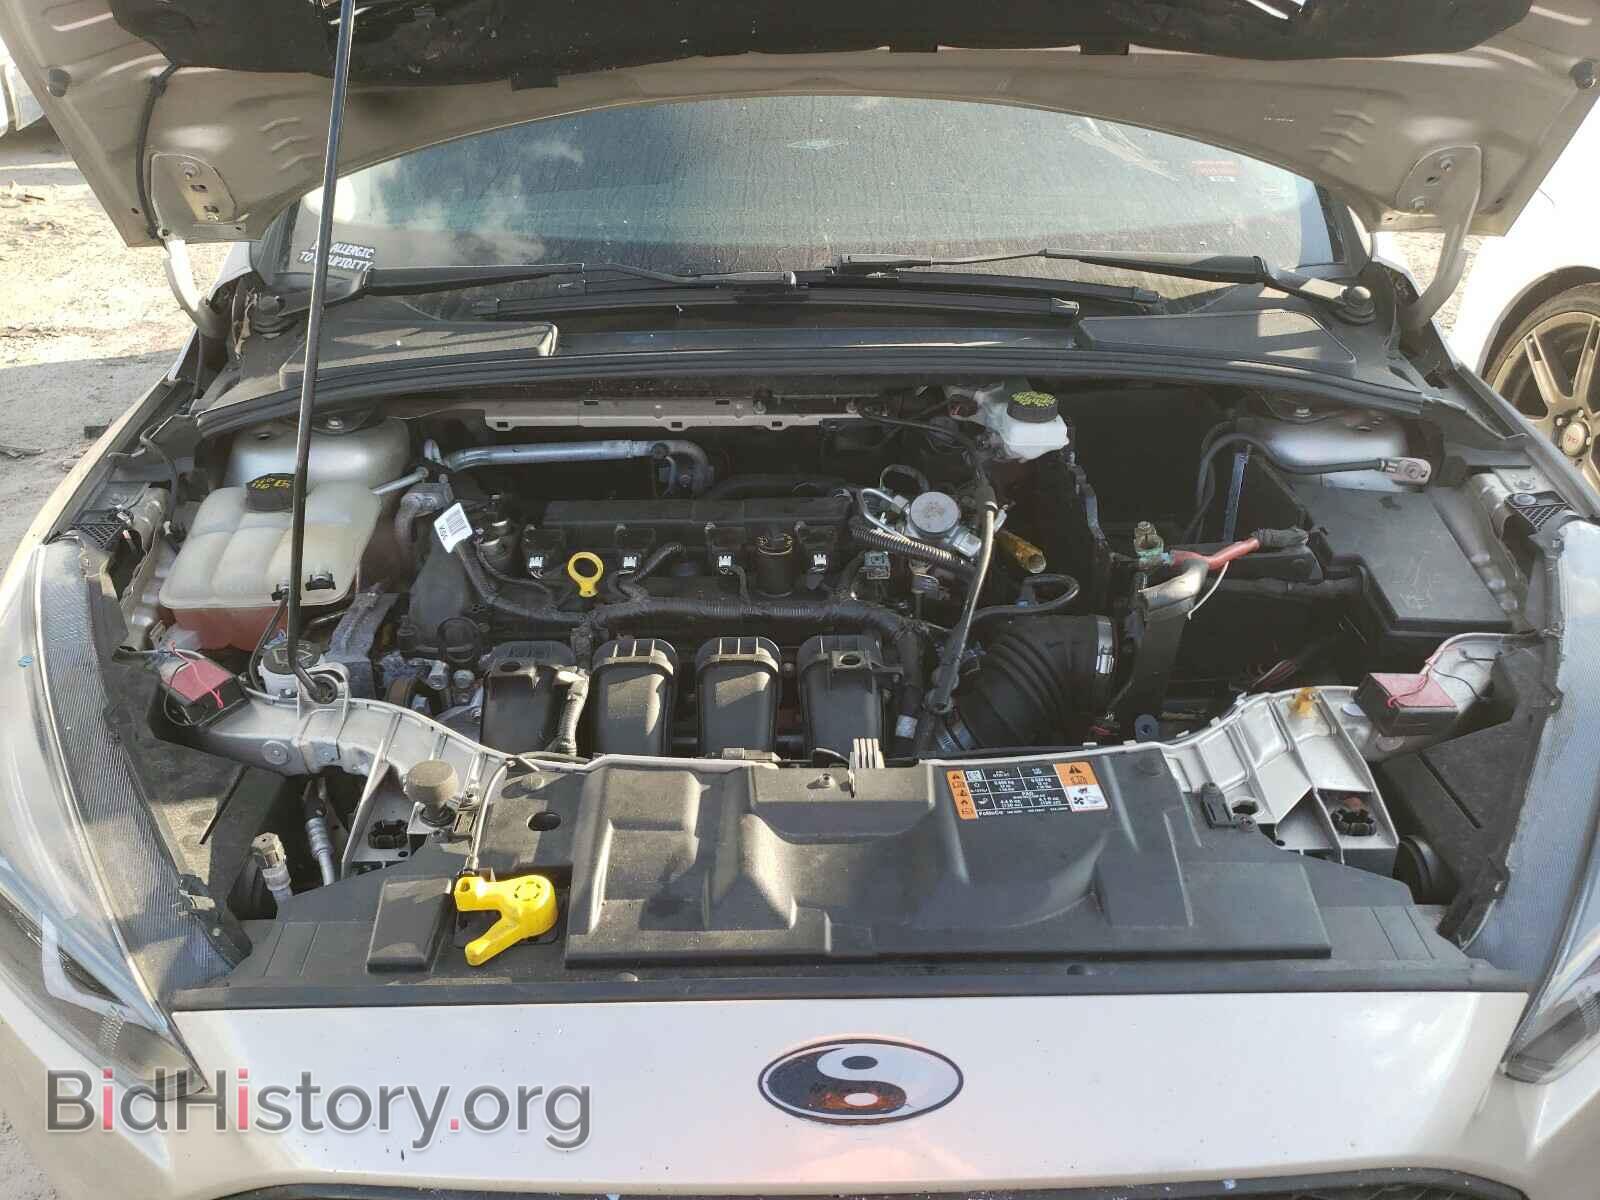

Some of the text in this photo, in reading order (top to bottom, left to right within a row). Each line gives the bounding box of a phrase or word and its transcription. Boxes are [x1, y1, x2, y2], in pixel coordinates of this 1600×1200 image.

[329, 243, 375, 258] ALLERGIC
[300, 251, 374, 271] TO UPIDITY
